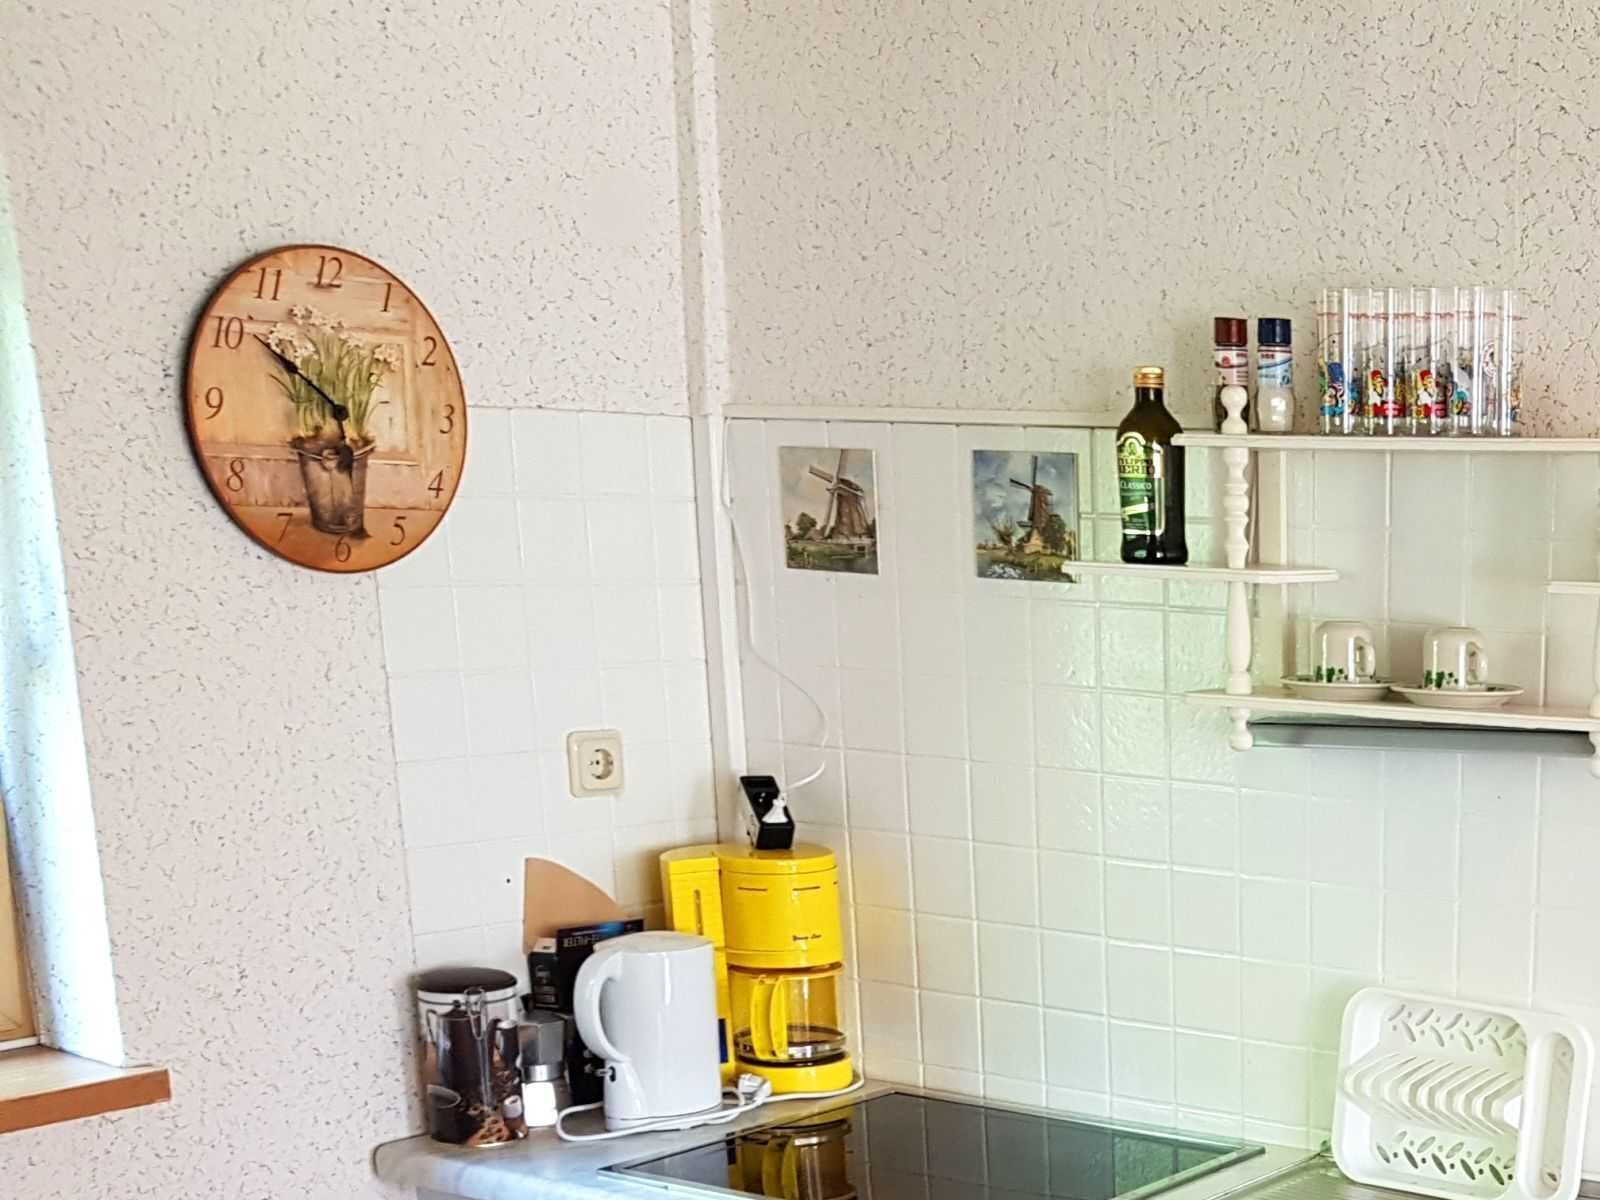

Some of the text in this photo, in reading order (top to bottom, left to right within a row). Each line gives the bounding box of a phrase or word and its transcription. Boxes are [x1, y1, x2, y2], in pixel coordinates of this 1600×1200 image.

[254, 268, 283, 301] 11
[315, 255, 343, 289] 12
[379, 282, 393, 313] 1
[212, 316, 244, 350] 10
[421, 336, 438, 367] 2
[204, 386, 224, 420] 9
[439, 404, 455, 435] 3
[226, 459, 246, 492] 8
[427, 470, 444, 499] 4
[276, 513, 294, 544] 7
[390, 516, 408, 546] 5
[333, 535, 351, 563] 6
